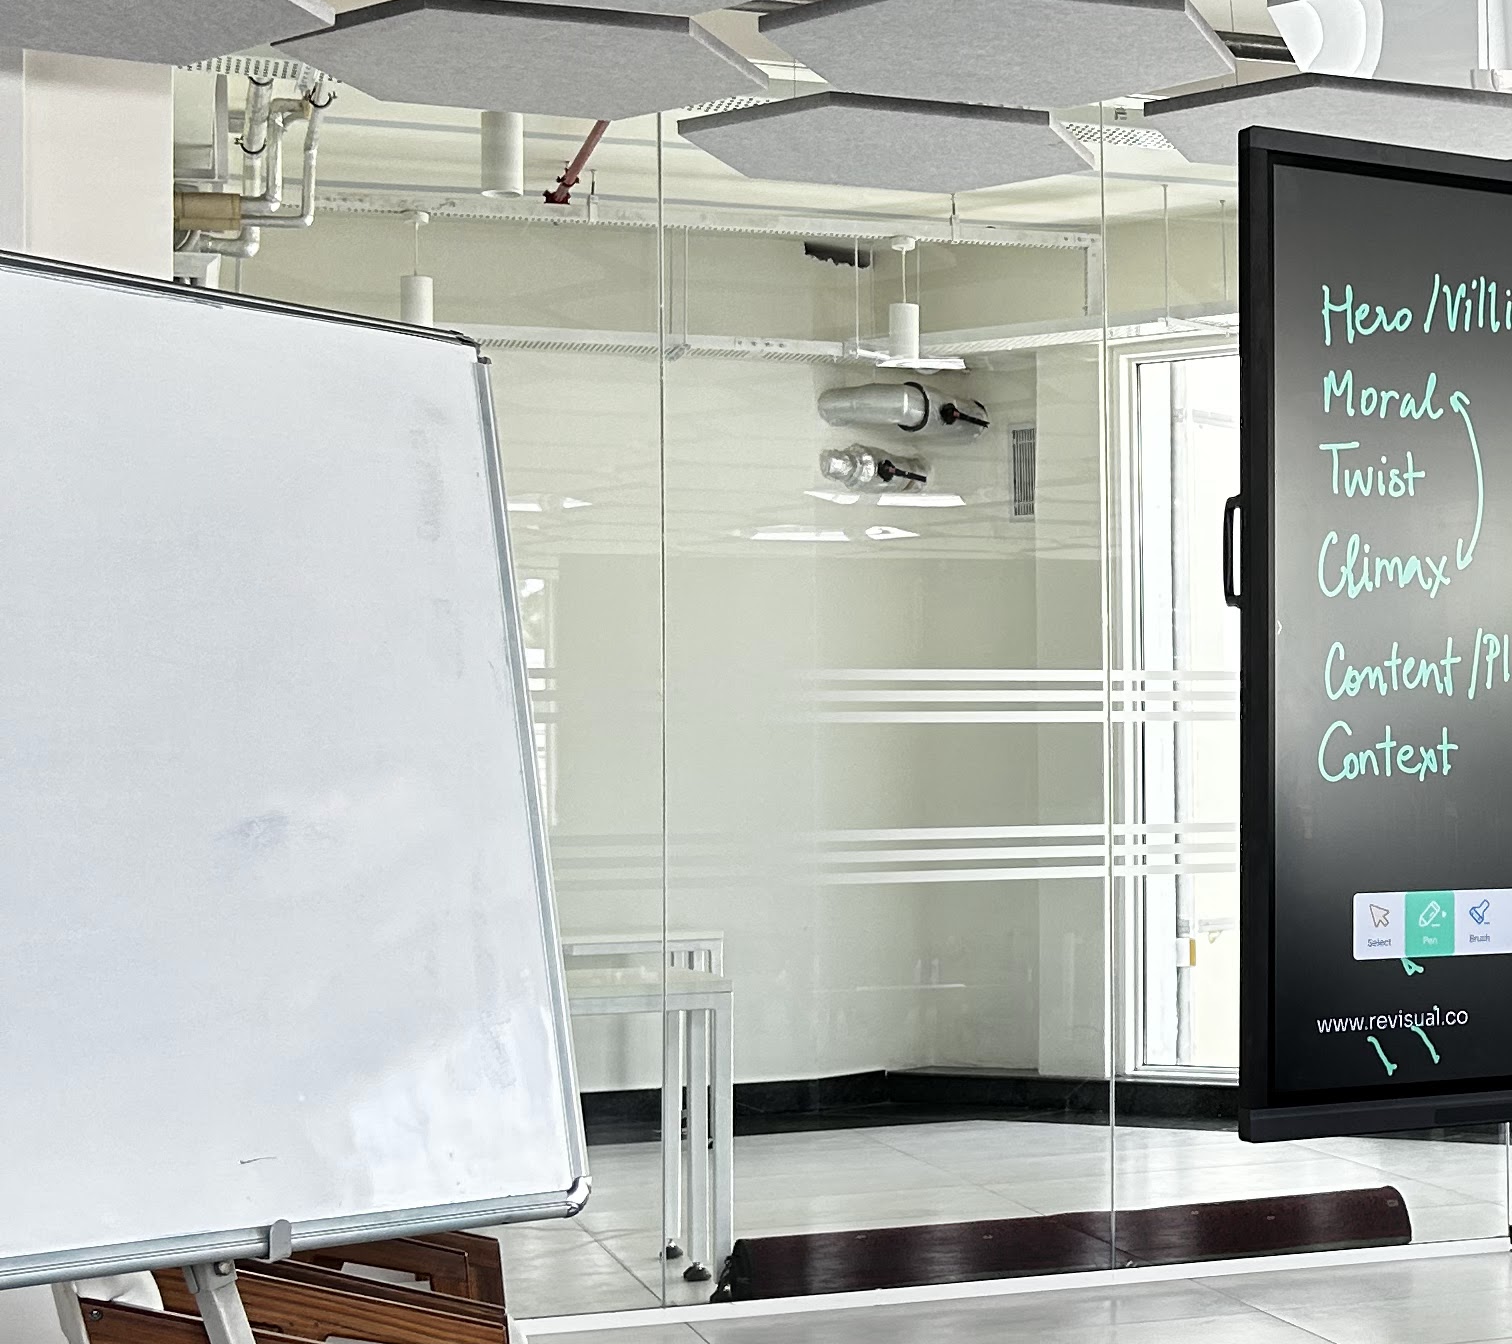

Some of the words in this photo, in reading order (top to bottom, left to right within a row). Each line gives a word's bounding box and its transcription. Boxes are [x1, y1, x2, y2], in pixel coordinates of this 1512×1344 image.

[1323, 369, 1443, 420] Moral
[1319, 441, 1425, 497] Twist
[1318, 530, 1450, 599] Climax
[1318, 721, 1459, 782] Context
[1422, 936, 1438, 945] Pen
[1316, 1006, 1470, 1034] www.revisual.co
